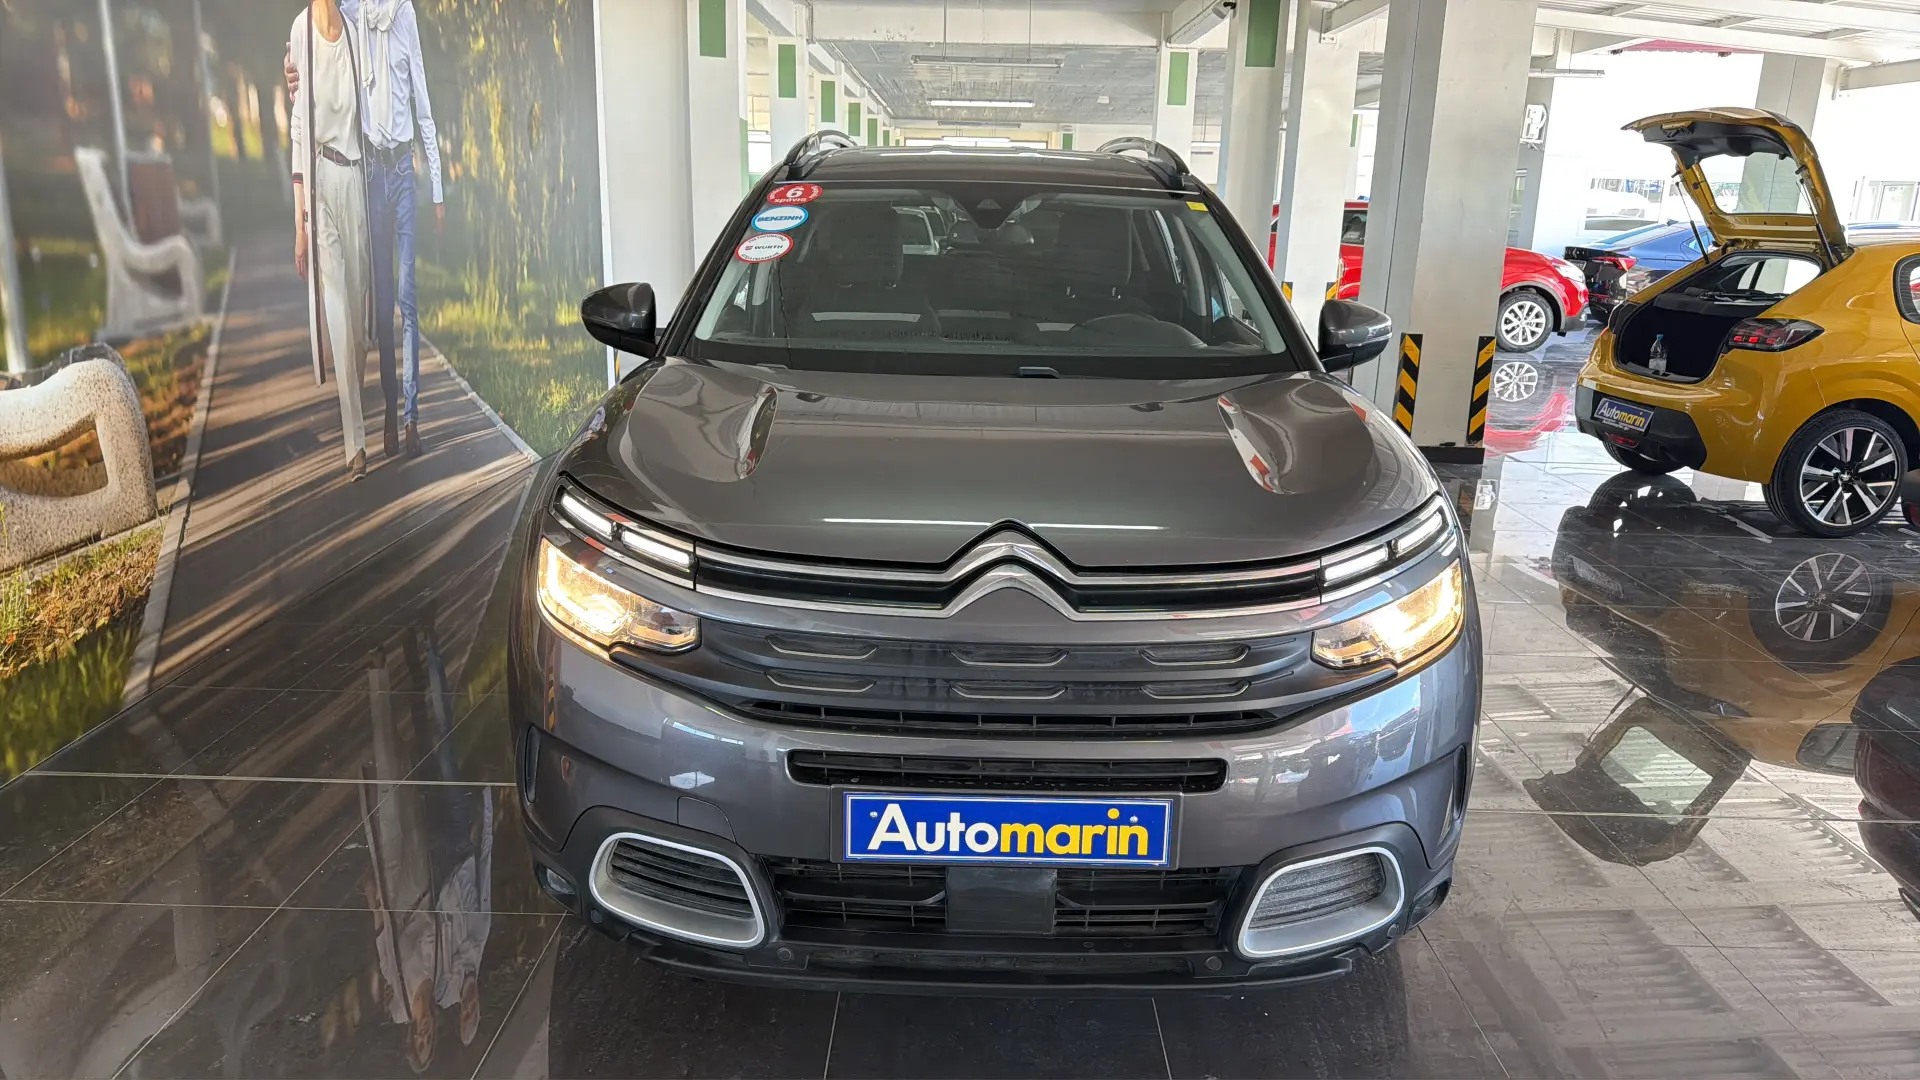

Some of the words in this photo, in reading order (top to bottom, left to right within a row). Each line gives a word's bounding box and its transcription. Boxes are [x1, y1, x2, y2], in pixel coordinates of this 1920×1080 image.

[786, 187, 805, 198] 6
[1598, 402, 1646, 427] Automarin
[867, 803, 1149, 856] Automarin
